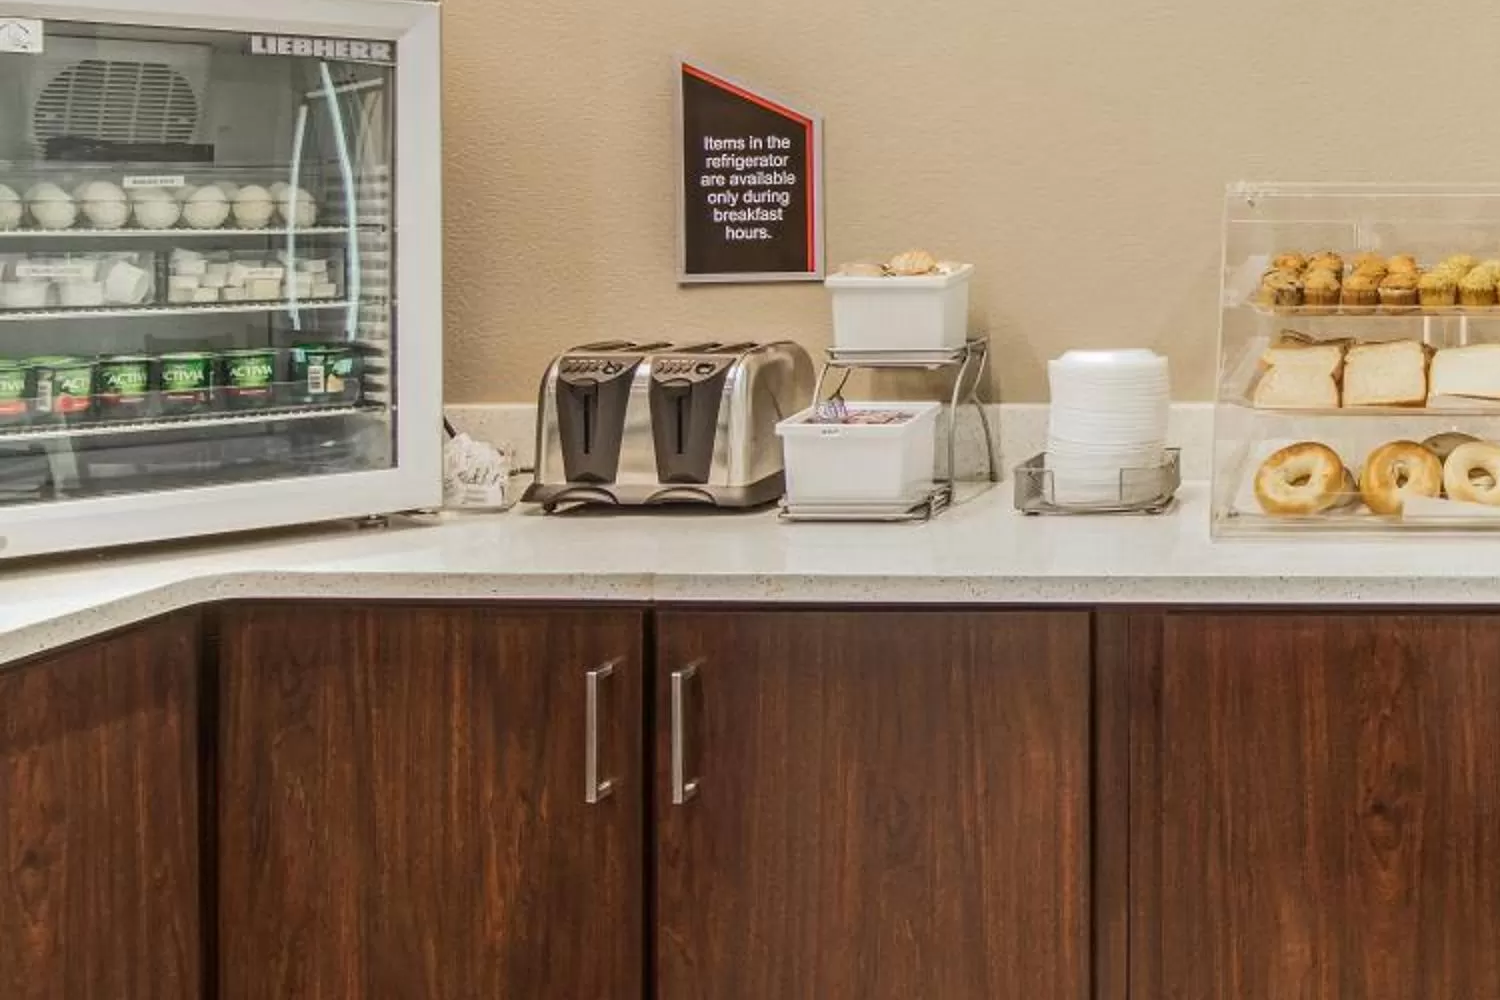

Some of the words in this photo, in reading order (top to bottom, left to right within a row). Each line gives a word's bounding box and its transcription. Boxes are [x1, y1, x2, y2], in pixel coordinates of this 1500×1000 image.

[251, 34, 394, 60] LIEBHERR
[704, 136, 745, 150] Items
[749, 135, 763, 149] in
[767, 135, 791, 149] the
[705, 154, 790, 171] refrigerator
[700, 174, 725, 187] are
[729, 171, 796, 186] available
[707, 190, 739, 206] only
[743, 189, 790, 205] during
[713, 207, 784, 222] breakfast
[725, 225, 773, 240] hours.
